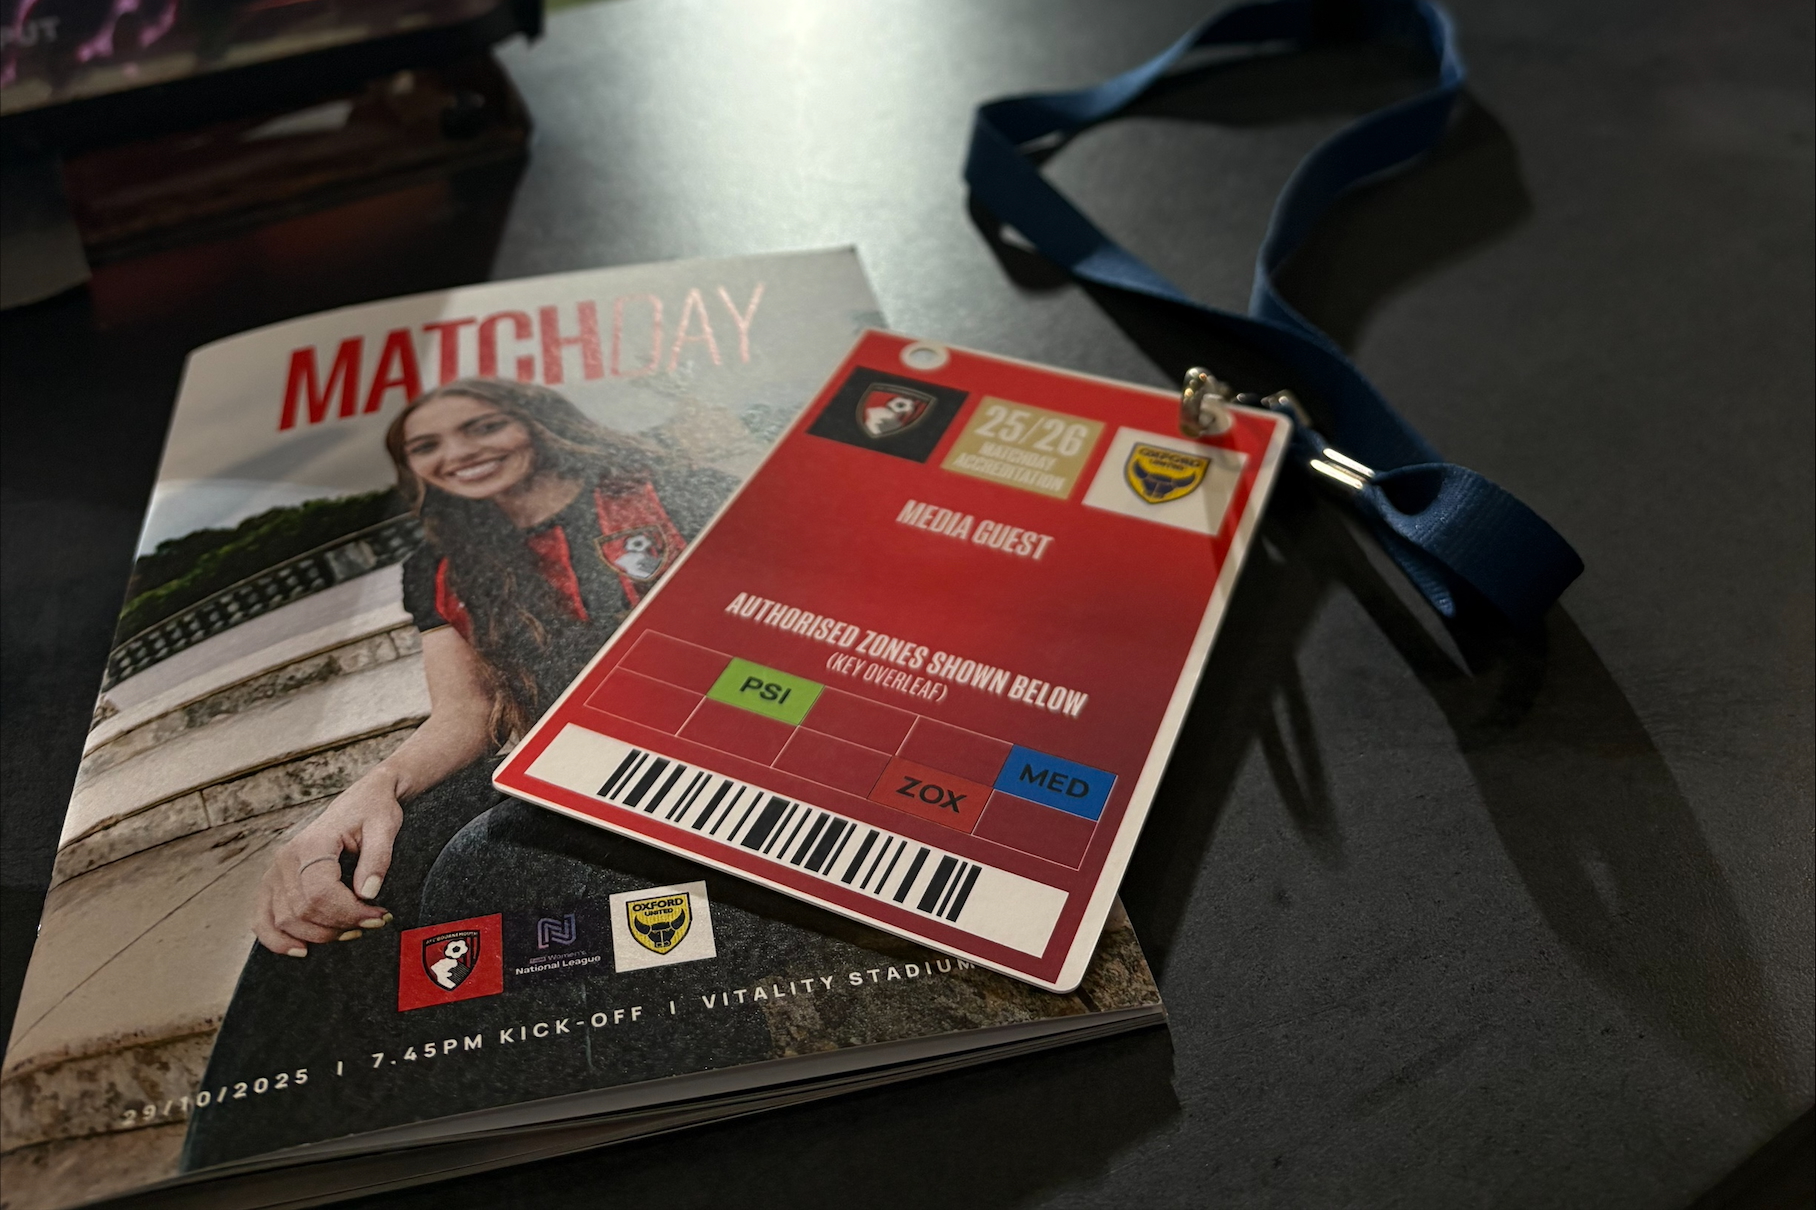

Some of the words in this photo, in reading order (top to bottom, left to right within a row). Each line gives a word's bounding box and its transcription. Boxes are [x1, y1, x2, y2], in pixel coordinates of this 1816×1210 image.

[278, 283, 765, 432] MATCHDAY
[975, 404, 1089, 457] 25/26
[952, 452, 1067, 491] ACCREDITATION
[978, 442, 1058, 471] MATCHDAY
[895, 499, 975, 540] MEDIA
[971, 519, 1055, 560] GUEST
[725, 592, 860, 649] AUTHORISED
[855, 629, 929, 670] ZONES
[926, 650, 1012, 694] SHOWN
[1007, 675, 1089, 718] BELOW
[739, 675, 792, 705] PSI
[826, 651, 866, 678] (KEY
[863, 662, 949, 703] OVERLEAF)
[896, 776, 968, 814] ZOX
[1019, 763, 1090, 799] MED
[632, 898, 684, 911] OXFORD
[644, 908, 674, 917] UNITED
[515, 961, 560, 975] National
[562, 955, 601, 967] League
[120, 1068, 309, 1127] 29/10/2025
[371, 1033, 484, 1069] 7.45PM
[500, 1005, 644, 1044] KICK-OFF
[701, 975, 834, 1009] VITALITY
[848, 957, 976, 986] STADIUM
